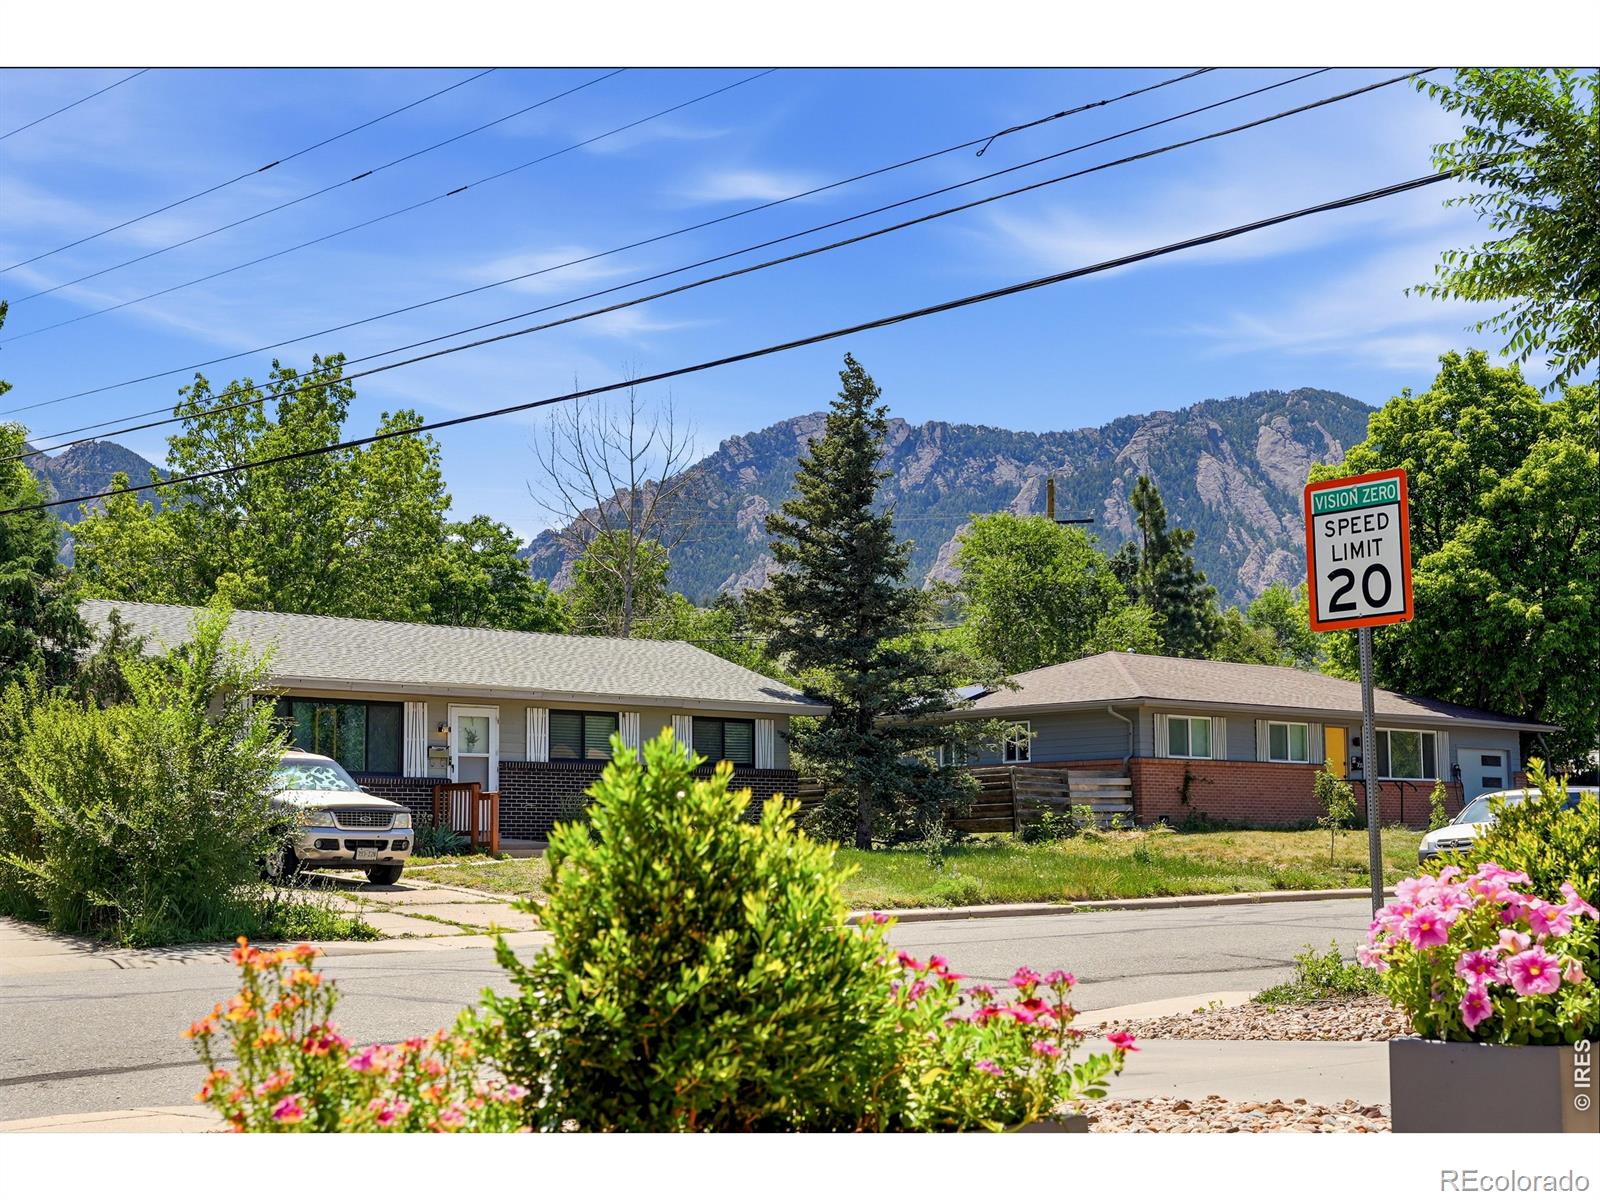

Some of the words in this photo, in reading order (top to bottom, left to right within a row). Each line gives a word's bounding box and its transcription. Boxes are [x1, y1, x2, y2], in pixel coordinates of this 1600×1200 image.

[1315, 487, 1358, 511] VISION
[1362, 484, 1396, 503] ZERO
[1324, 512, 1389, 538] SPEED
[1331, 538, 1383, 562] LIMIT
[1327, 563, 1392, 613] 20
